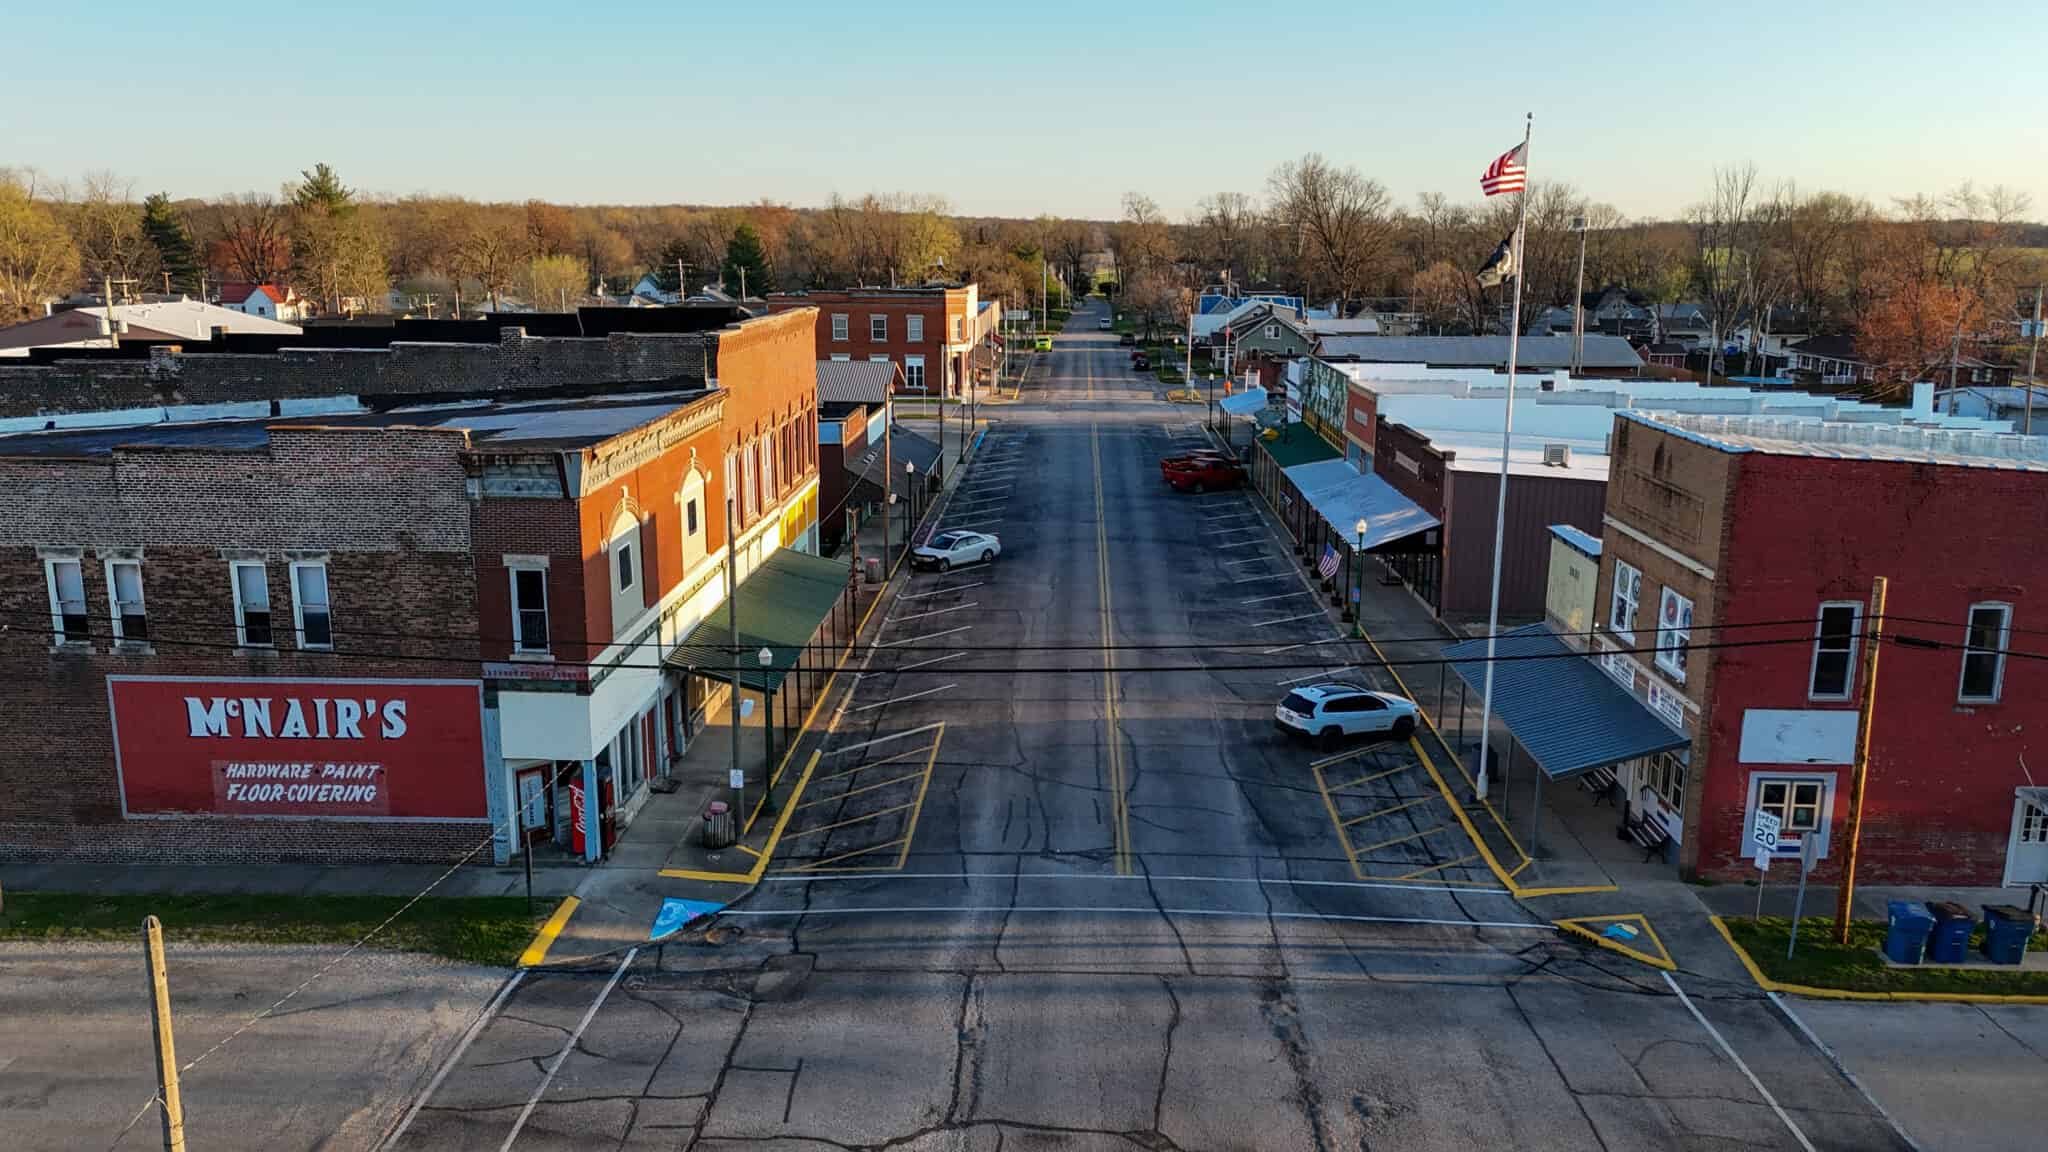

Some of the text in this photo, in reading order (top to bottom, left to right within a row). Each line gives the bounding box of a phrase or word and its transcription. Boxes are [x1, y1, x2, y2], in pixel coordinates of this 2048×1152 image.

[184, 696, 408, 739] McNAIR'S
[225, 763, 378, 779] HARDWARE PAINT
[226, 783, 377, 802] FLOOR-COVERING
[1758, 812, 1778, 826] SPEED
[1758, 821, 1776, 833] LIMIT
[1755, 827, 1776, 846] 20
